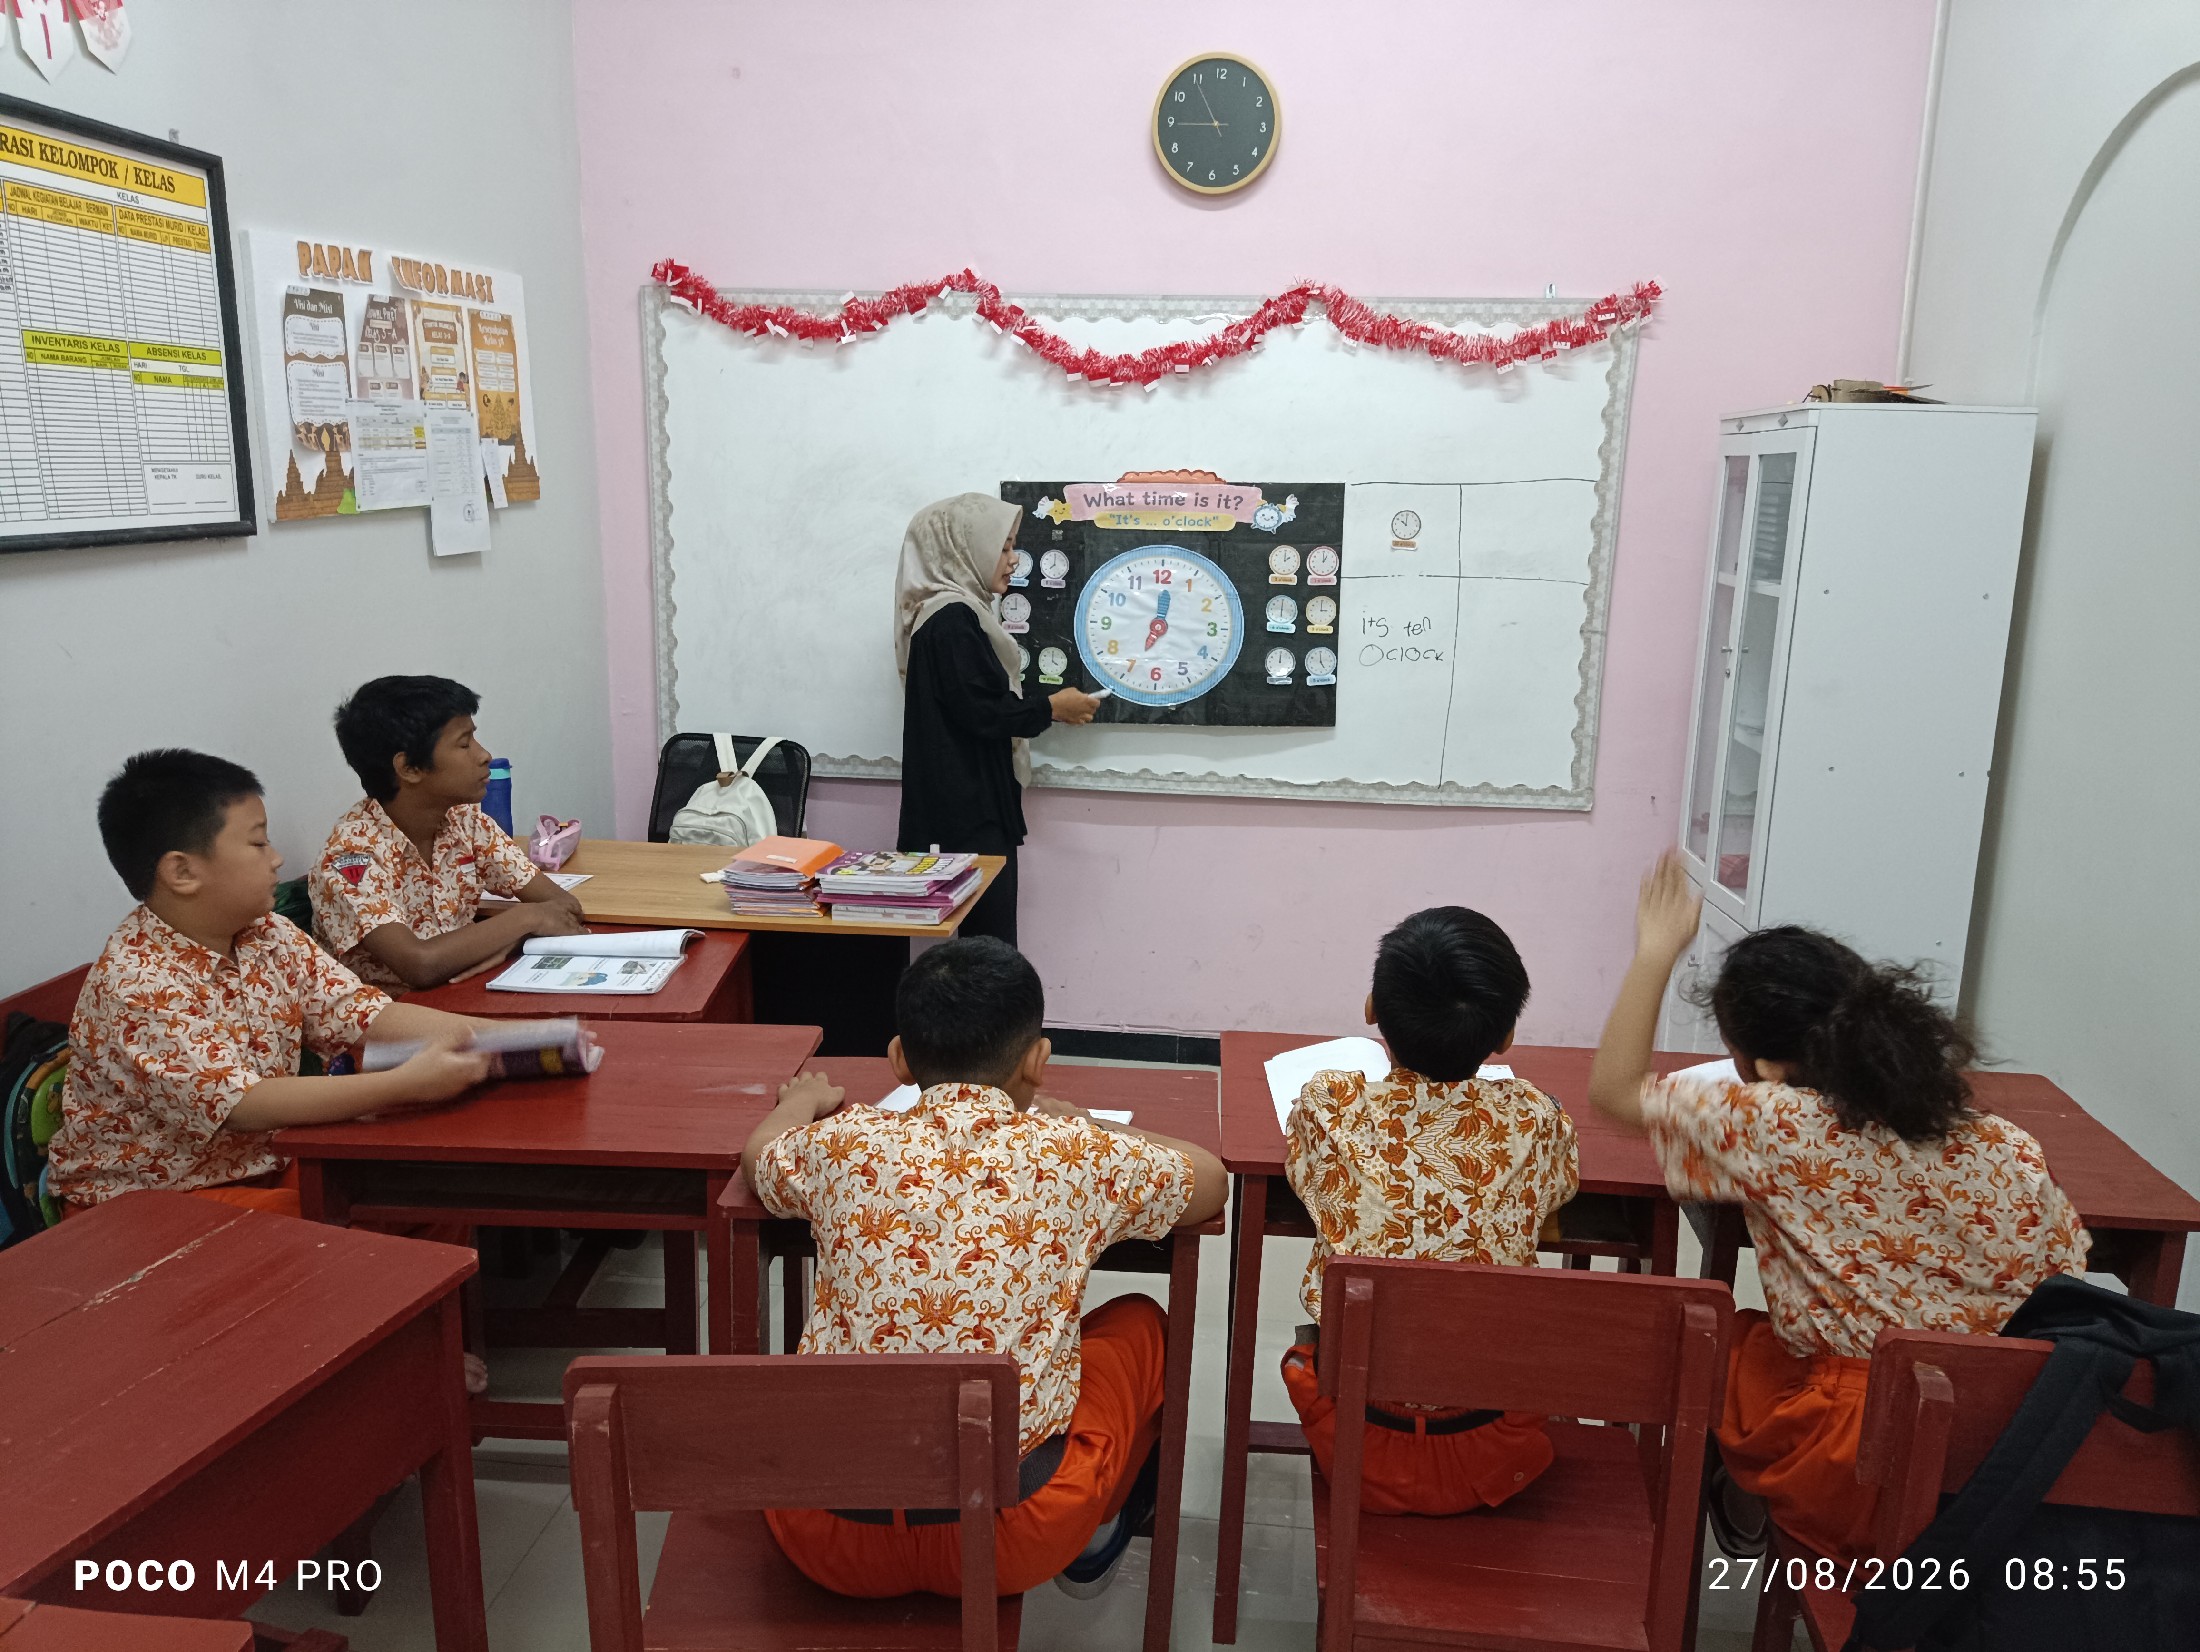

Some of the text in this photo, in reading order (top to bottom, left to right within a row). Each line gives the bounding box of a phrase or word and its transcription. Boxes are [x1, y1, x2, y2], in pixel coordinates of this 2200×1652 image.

[1194, 73, 1202, 84] 11
[1216, 68, 1228, 80] 12
[1242, 76, 1246, 88] 1
[1174, 92, 1186, 102] 10
[1256, 96, 1262, 108] 2
[1168, 116, 1174, 128] 9
[1260, 122, 1266, 132] 3
[1172, 142, 1178, 154] 8
[1252, 147, 1258, 158] 4
[0, 132, 176, 194] RASI KELOMPOK / KELAS
[1186, 162, 1194, 172] 7
[1232, 164, 1240, 176] 5
[1208, 170, 1216, 181] 6
[10, 186, 31, 200] JADWAL
[117, 192, 140, 204] KELAS
[21, 206, 38, 216] HARI
[79, 218, 99, 228] WAKTU
[119, 209, 135, 220] DATA
[136, 212, 165, 229] PRESTASI
[187, 225, 206, 237] KELAS
[297, 240, 495, 303] PAPAN INFORMASI
[31, 335, 120, 353] INVENTARIS KELAS
[41, 353, 60, 361] NAMA
[146, 346, 207, 361] ABSENSI KELAS
[153, 375, 172, 384] NAMA
[1083, 491, 1244, 511] What time is it?
[1128, 576, 1142, 590] 11
[1152, 569, 1172, 585] 12
[1185, 578, 1193, 592] 1
[1108, 592, 1126, 607] 10
[1202, 598, 1212, 612] 2
[1101, 616, 1112, 631] 9
[1206, 622, 1218, 636] 3
[1107, 639, 1120, 655] 8
[1196, 646, 1208, 659] 4
[1126, 659, 1136, 673] 7
[1178, 662, 1188, 676] 5
[1150, 666, 1162, 681] 6
